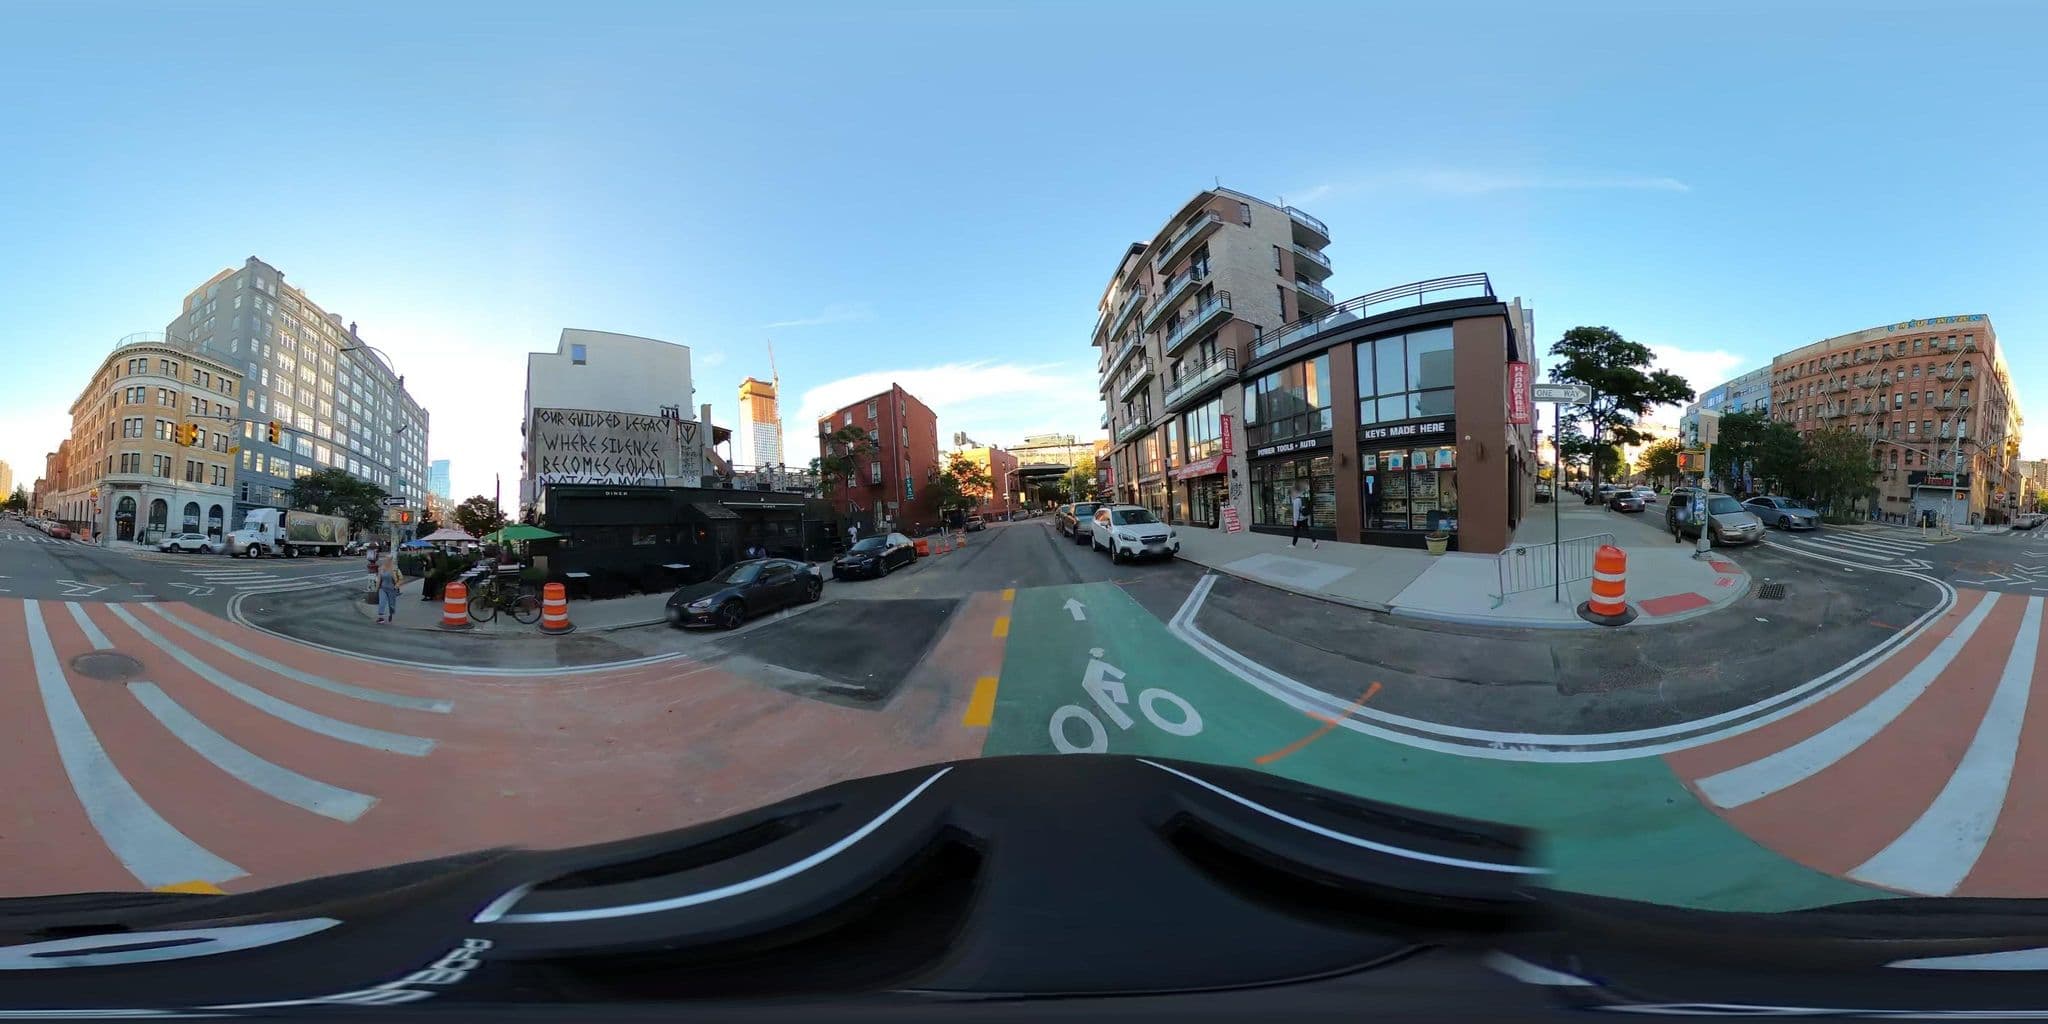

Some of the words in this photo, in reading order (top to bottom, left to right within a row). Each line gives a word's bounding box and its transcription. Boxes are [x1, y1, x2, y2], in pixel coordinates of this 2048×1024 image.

[1536, 389, 1553, 397] ONE
[1563, 389, 1579, 397] WAY
[540, 410, 565, 426] OUR
[568, 411, 621, 429] GUILDED
[625, 415, 670, 435] LEGACY
[1365, 428, 1386, 439] KEYS
[1389, 425, 1416, 437] MADE
[1420, 422, 1445, 433] HERE
[542, 432, 597, 454] WHERE
[600, 437, 659, 458] SILENCE
[1257, 446, 1275, 457] POWER
[1276, 443, 1294, 453] TOOLS
[1299, 439, 1316, 449] AUTO
[542, 455, 612, 477] BECOMES
[615, 456, 666, 478] GOLDEN
